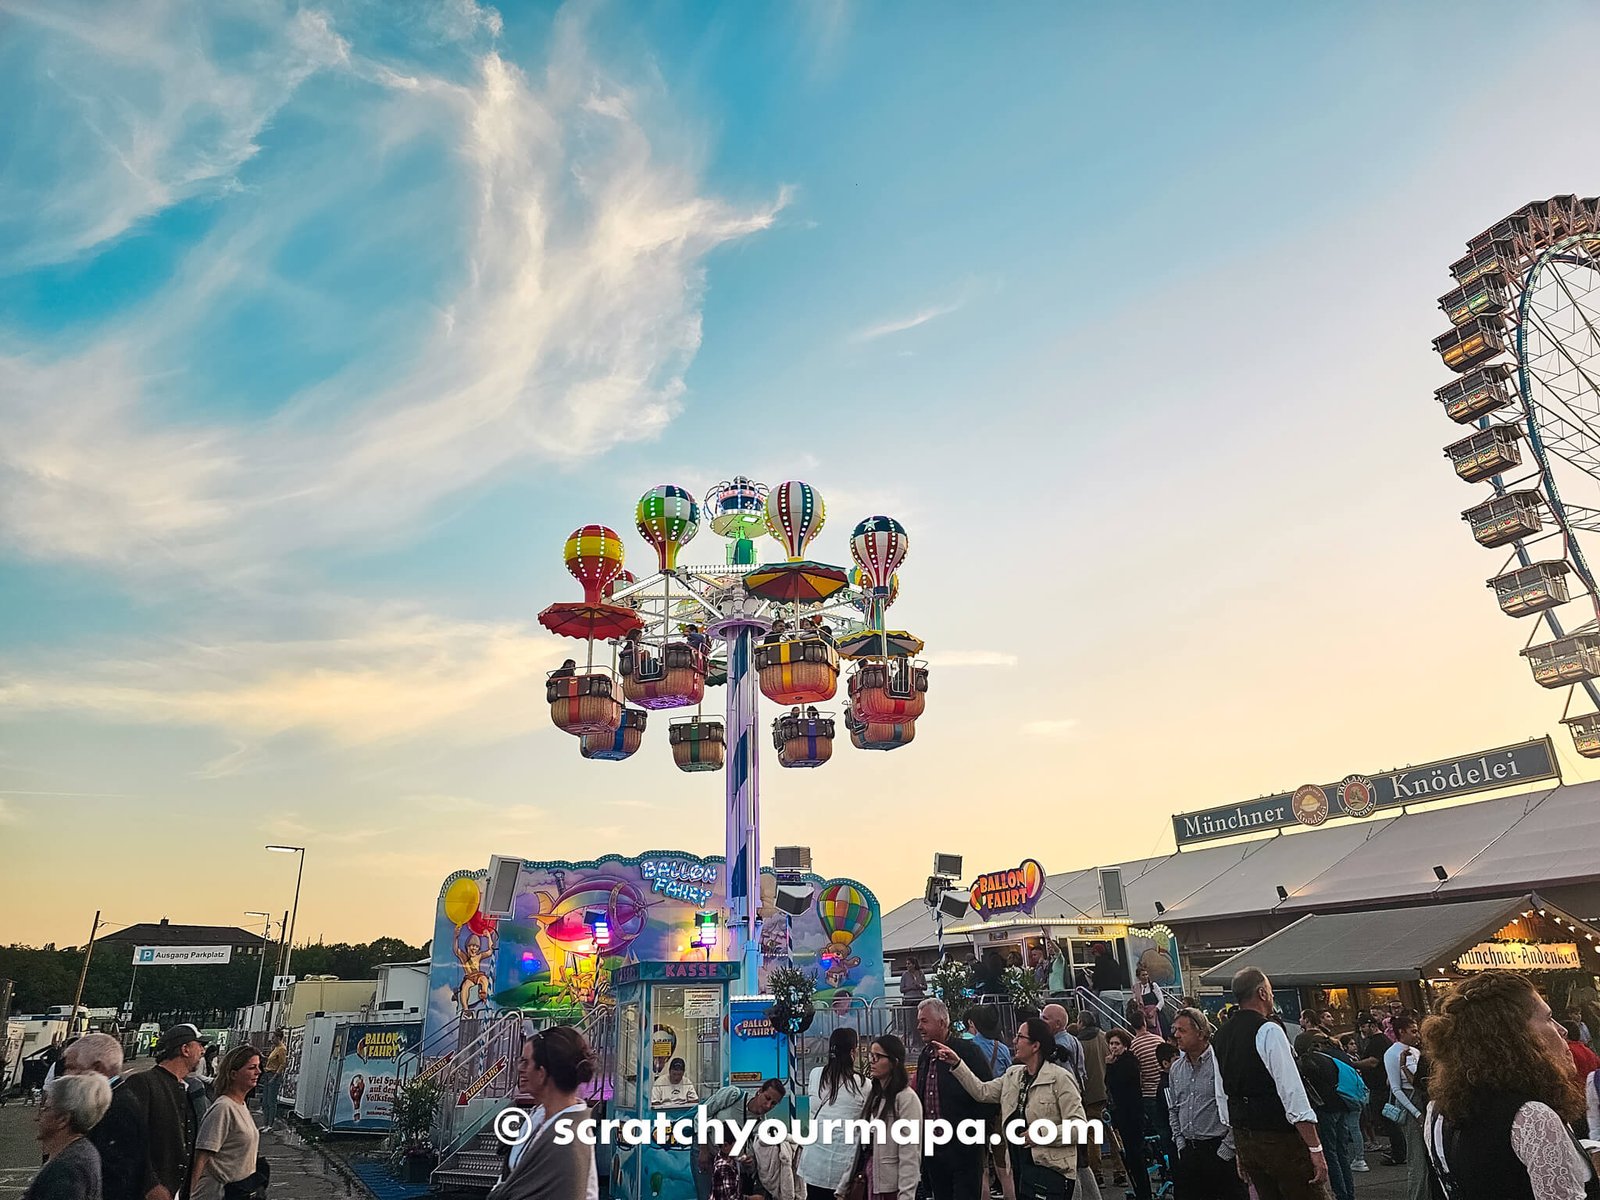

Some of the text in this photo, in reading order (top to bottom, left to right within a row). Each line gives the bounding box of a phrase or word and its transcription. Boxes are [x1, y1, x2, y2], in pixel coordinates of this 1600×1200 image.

[1184, 752, 1521, 838] Münchner Knödelei
[1338, 774, 1373, 796] PAULANER
[641, 861, 717, 882] BALLON
[979, 869, 1026, 893] BALLON
[654, 877, 712, 907] FAHRT
[987, 887, 1028, 909] FAHRT
[155, 951, 189, 960] Ausgang
[190, 951, 225, 960] Parkplatz
[665, 964, 717, 977] KASSE
[368, 1045, 398, 1057] FAHRT
[368, 1076, 383, 1085] Viel
[369, 1085, 383, 1093] auf
[465, 1065, 499, 1100] AUSGANG
